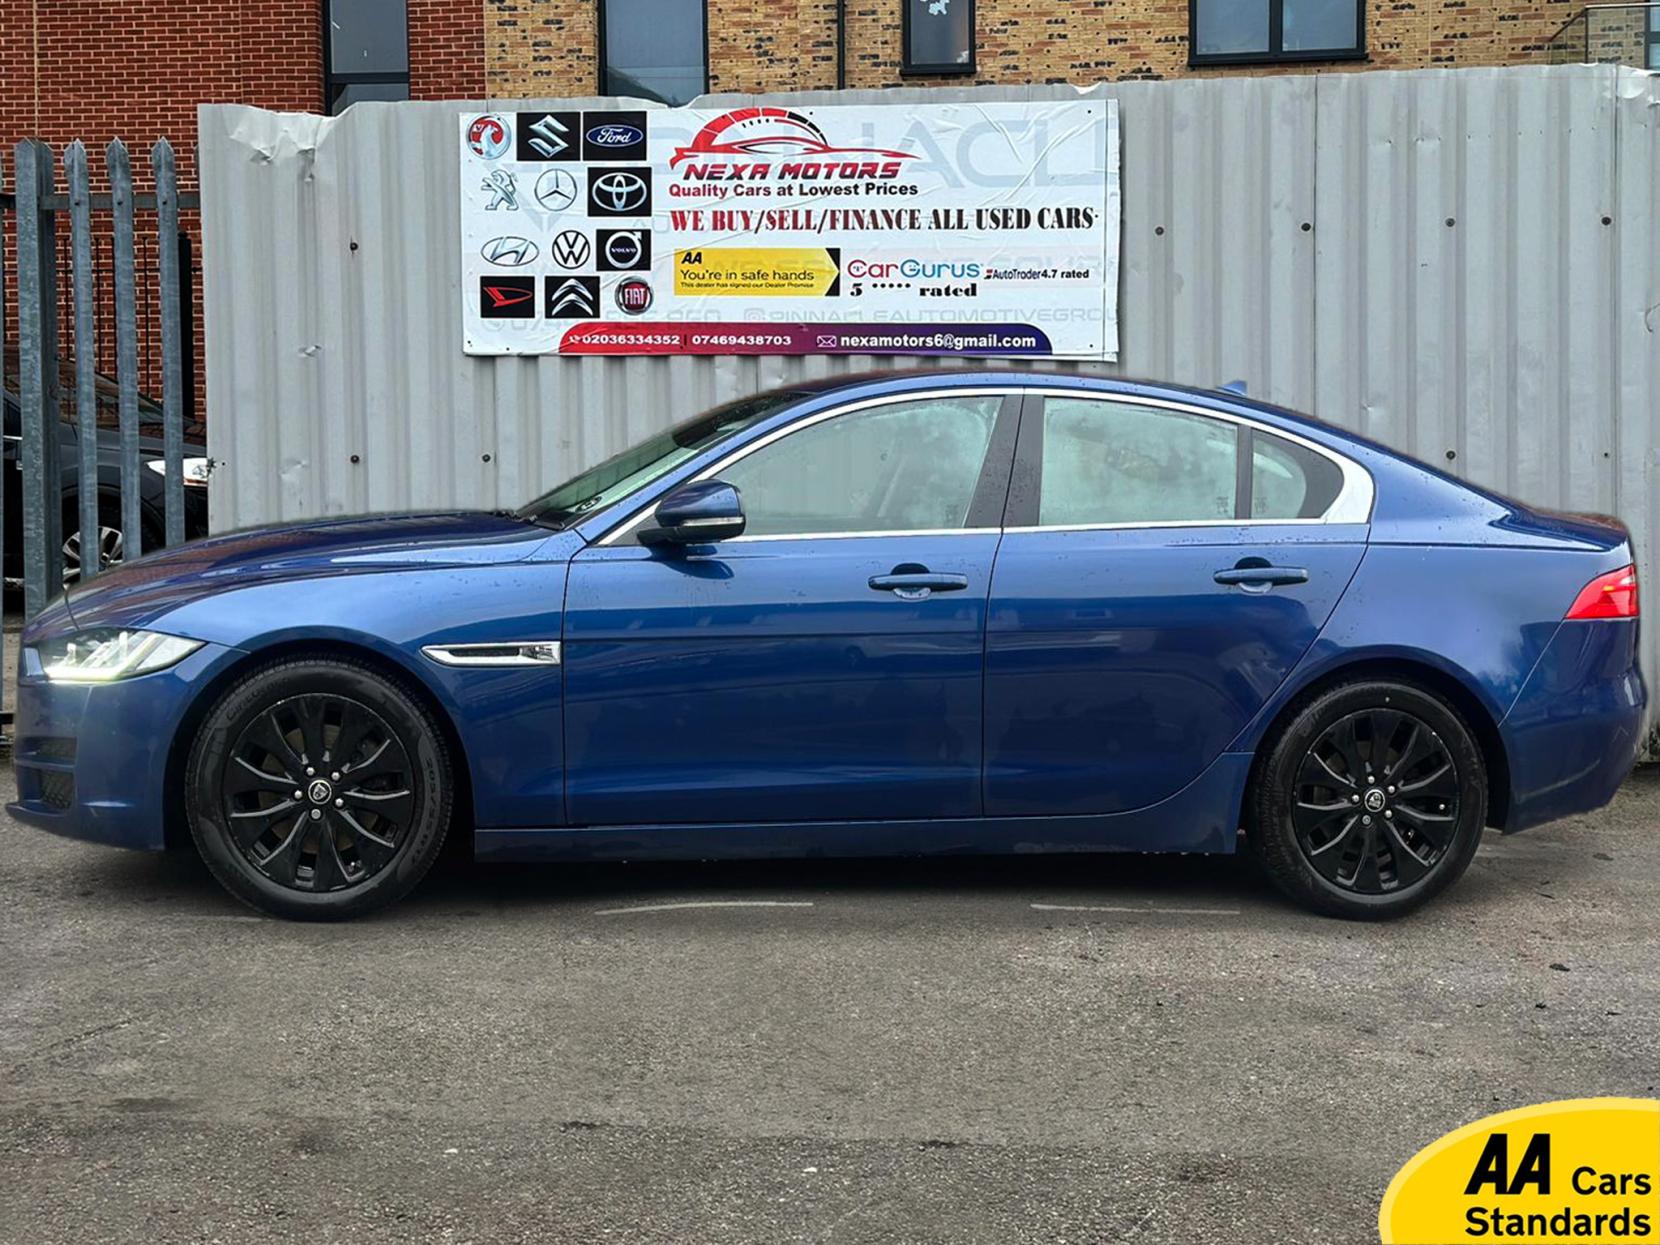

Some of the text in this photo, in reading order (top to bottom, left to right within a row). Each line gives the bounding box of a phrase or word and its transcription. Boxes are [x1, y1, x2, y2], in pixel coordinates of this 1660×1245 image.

[596, 128, 632, 143] Ford
[683, 162, 902, 181] NEXA MOTORS
[669, 181, 918, 200] Quality Cars at Lowest Prices
[670, 209, 704, 231] WE
[711, 208, 921, 234] BUY/SELL/FINANCE
[928, 208, 968, 230] ALL
[975, 208, 1031, 230] USED
[1037, 206, 1094, 230] CARS
[681, 251, 703, 265] AA
[680, 269, 815, 281] You're in safe hands
[847, 258, 980, 279] CarGurus
[1041, 268, 1058, 279] 4.7
[1060, 268, 1090, 279] rated
[729, 281, 751, 289] signed
[850, 282, 978, 298] 5 rated
[624, 287, 645, 306] FIAT
[583, 335, 792, 346] 02036334352 07469438703
[840, 333, 1036, 350] nexamotors6@gmail.com
